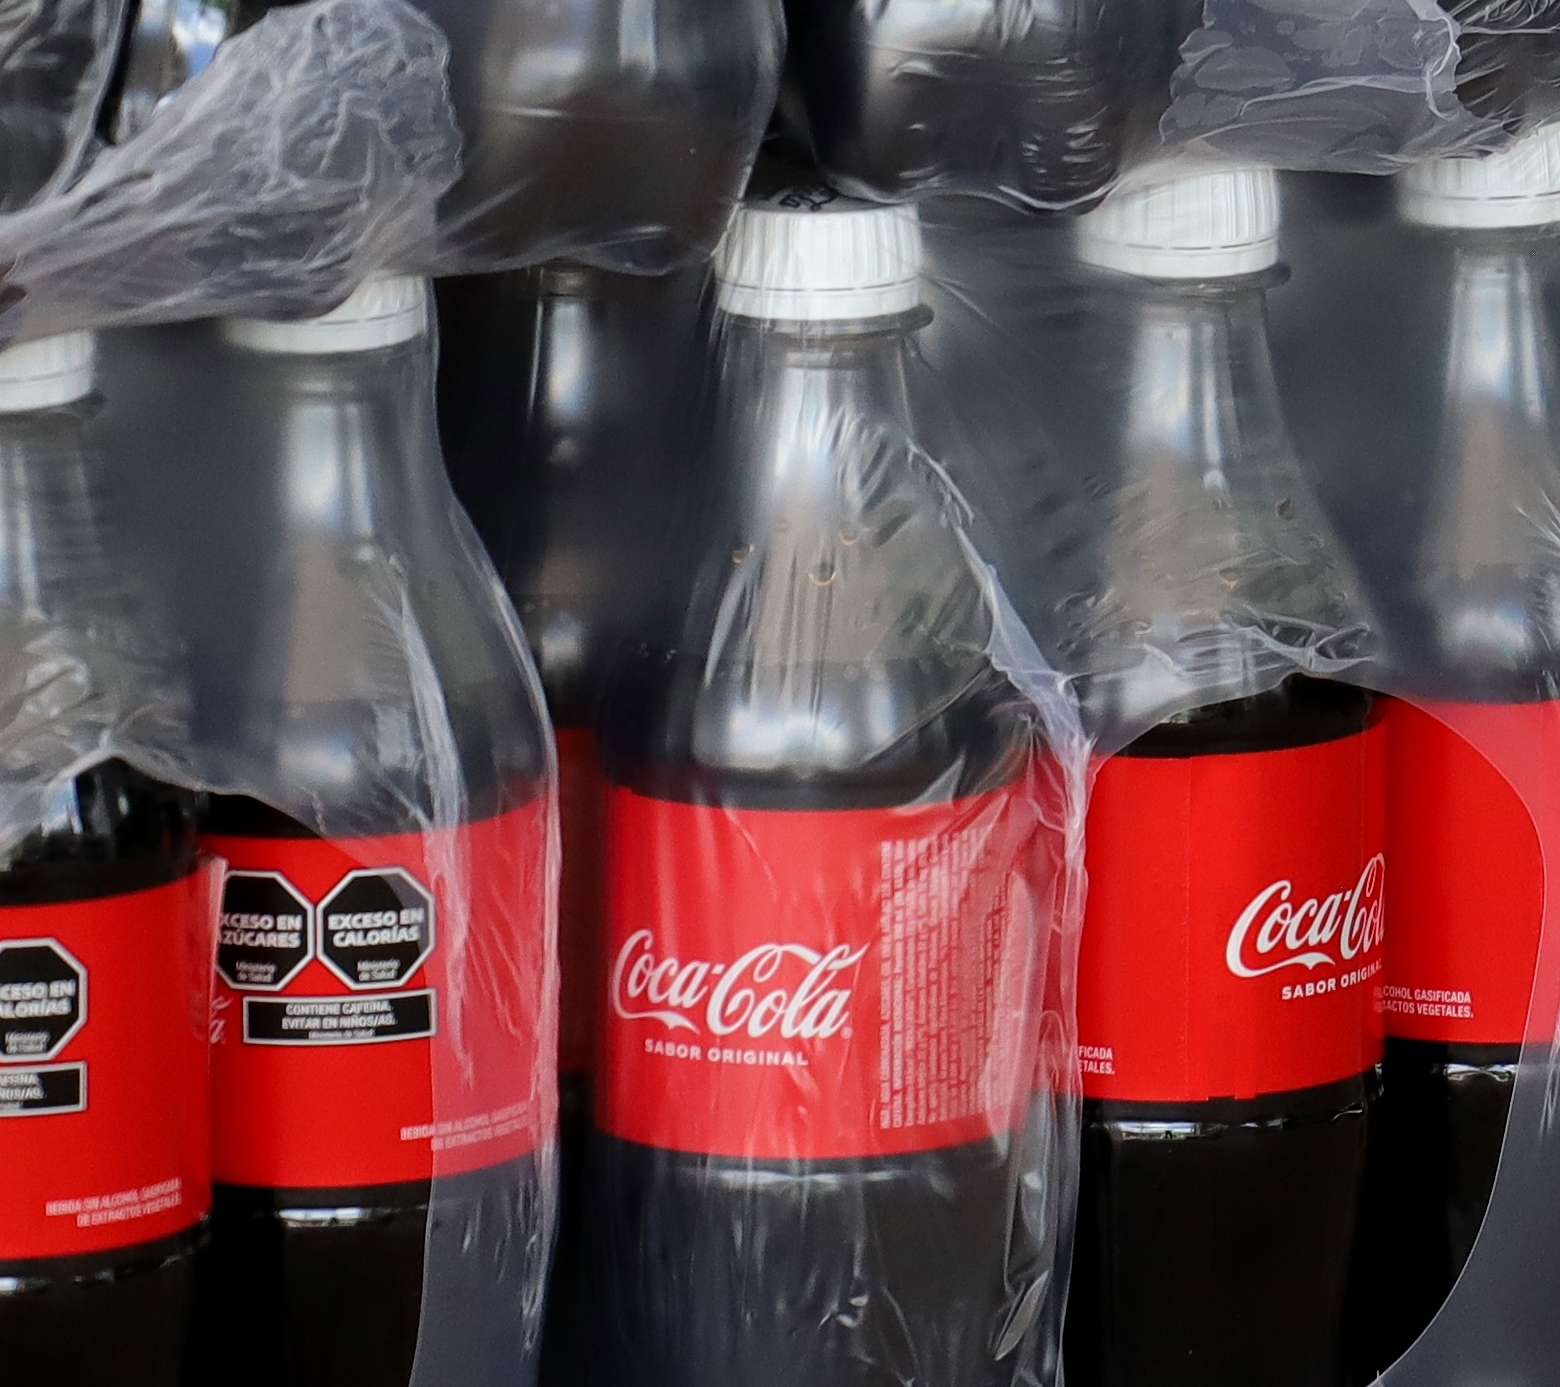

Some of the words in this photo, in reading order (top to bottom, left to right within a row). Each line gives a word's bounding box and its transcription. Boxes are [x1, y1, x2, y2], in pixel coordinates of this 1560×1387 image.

[276, 914, 302, 930] EN
[328, 910, 396, 930] EXCESO
[399, 907, 425, 925] EN
[333, 924, 420, 948] CALORÍAS
[49, 979, 77, 997] EN
[613, 928, 871, 1040] Coca-Cola
[1281, 977, 1337, 1001] SABOR
[1414, 989, 1472, 1004] GASIFICADA
[286, 1002, 340, 1016] CONTIENE
[1417, 1004, 1474, 1019] VEGETALES.
[282, 1016, 321, 1030] EVITAR
[644, 1038, 702, 1060] SABOR
[708, 1045, 809, 1067] ORIGINAL
